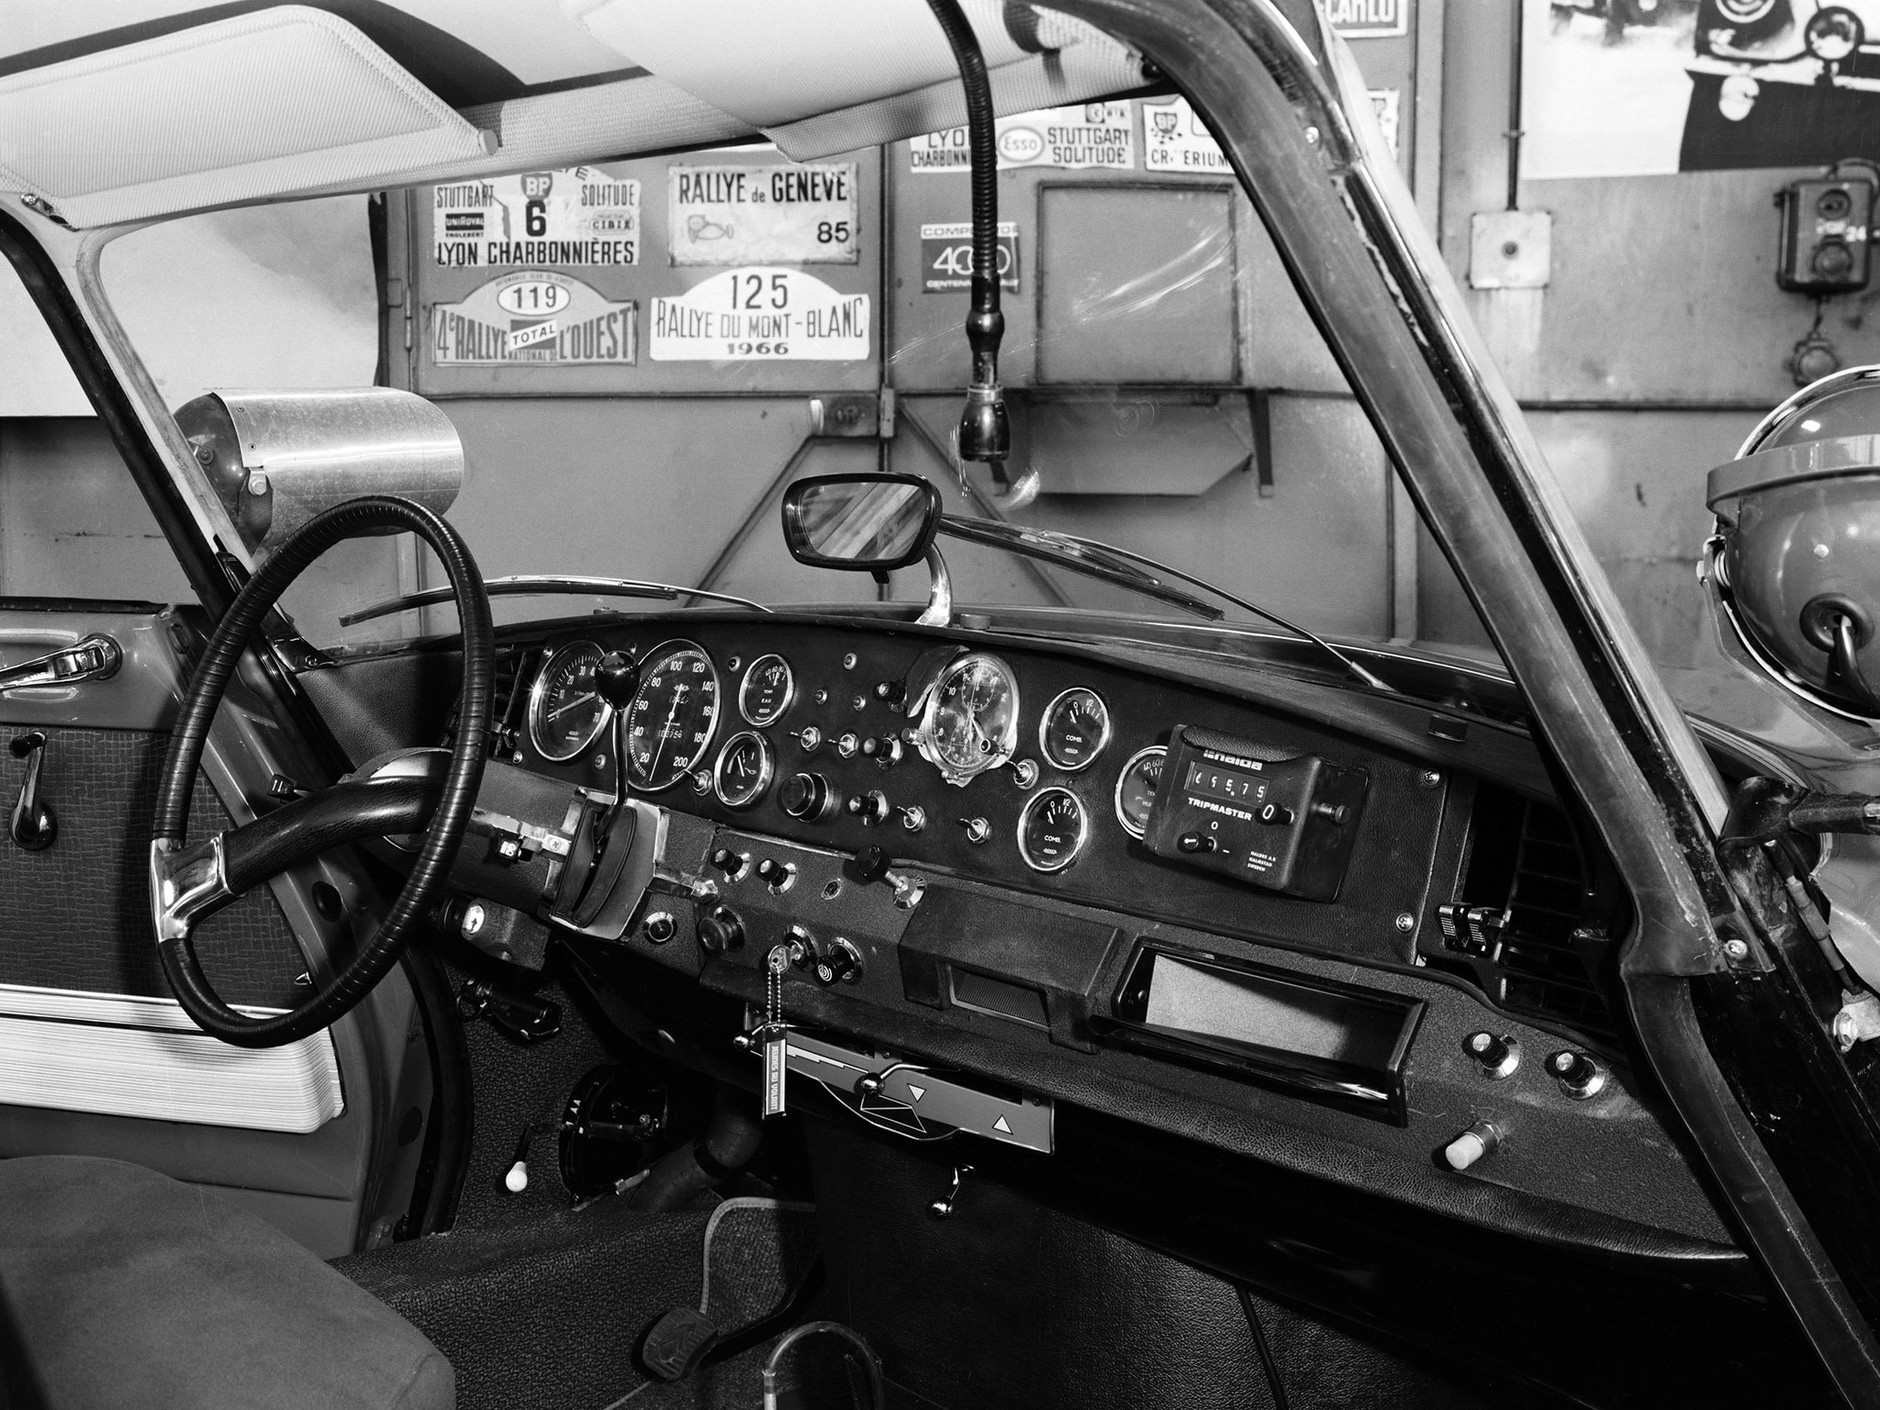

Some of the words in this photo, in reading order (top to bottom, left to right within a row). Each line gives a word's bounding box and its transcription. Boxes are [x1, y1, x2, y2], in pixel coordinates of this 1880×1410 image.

[928, 129, 971, 148] LYO
[1047, 127, 1130, 145] STUTTGART
[1053, 146, 1126, 164] SOLITUDE
[525, 176, 551, 197] BP
[581, 184, 635, 206] SOLITUDE
[679, 173, 746, 204] RALLYE
[751, 187, 765, 203] de
[436, 185, 494, 208] STUTTGART
[525, 199, 546, 237] 6
[817, 221, 850, 243] 85
[437, 241, 478, 265] LYON
[487, 237, 634, 265] CHARBONNIÈRES
[511, 285, 557, 309] 119
[731, 275, 788, 310] 125
[656, 298, 713, 338] RALLYE
[720, 314, 740, 338] DU
[455, 314, 507, 359] RALLYE
[559, 306, 631, 360] L'OUEST
[512, 324, 555, 345] TOTAL
[727, 342, 790, 355] 1966
[669, 661, 683, 671] 100
[692, 662, 705, 673] 120
[651, 677, 661, 687] 80
[701, 681, 714, 691] 140
[638, 700, 648, 711] 60
[702, 706, 714, 716] 160
[633, 726, 644, 737] 40
[693, 732, 707, 743] 180
[639, 752, 650, 763] 20
[673, 756, 689, 767] 200
[1188, 797, 1253, 821] TRIPMASTER
